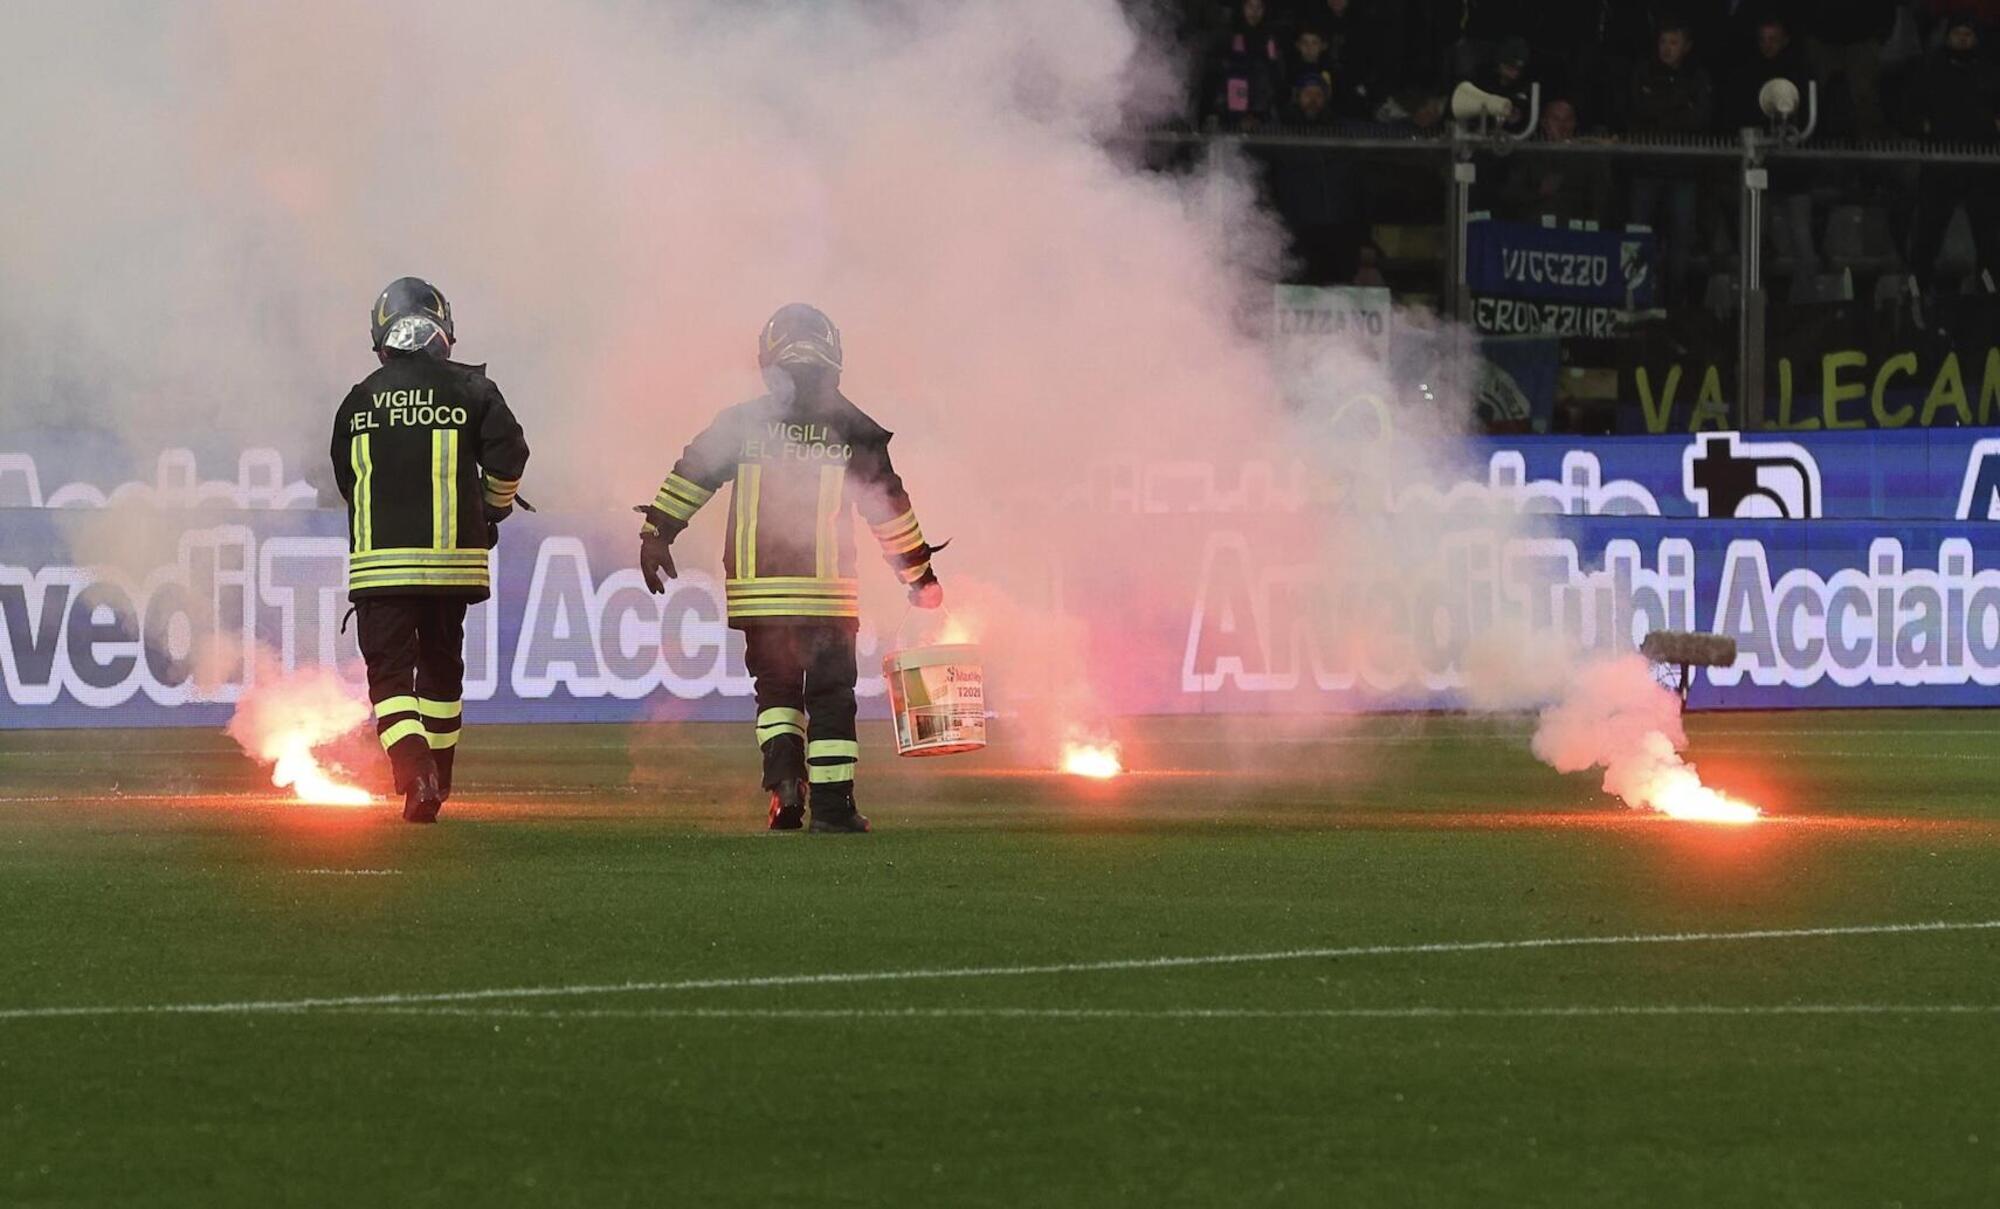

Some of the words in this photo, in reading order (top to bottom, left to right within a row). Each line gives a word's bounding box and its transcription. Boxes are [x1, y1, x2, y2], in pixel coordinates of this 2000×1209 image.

[372, 388, 434, 409] VIGILI
[1634, 347, 2000, 433] VALECA
[350, 410, 380, 433] EL
[389, 405, 468, 427] FUOCO
[766, 422, 828, 442] VIGILI
[783, 441, 853, 461] FUOCO
